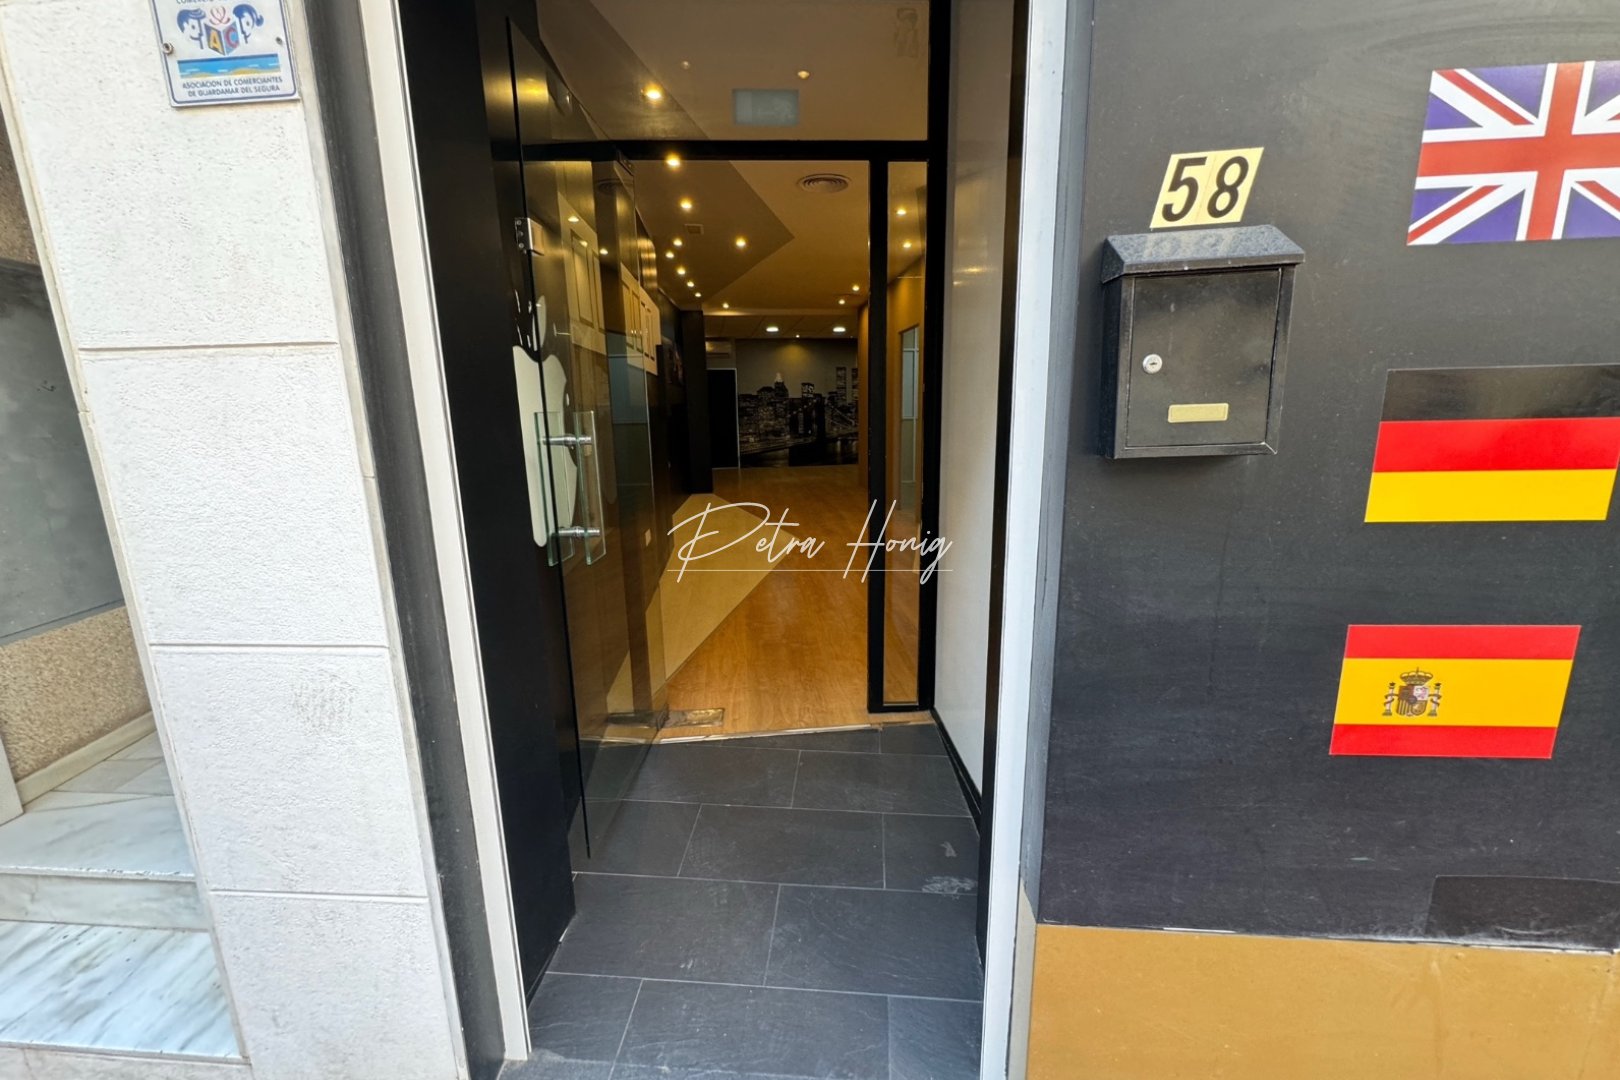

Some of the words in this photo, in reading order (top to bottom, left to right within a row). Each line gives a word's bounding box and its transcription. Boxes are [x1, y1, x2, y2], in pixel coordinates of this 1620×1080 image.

[223, 79, 232, 87] DE
[233, 76, 283, 86] COMERCIANTES
[198, 88, 239, 96] GUARDAMAR
[240, 86, 253, 94] DEL
[254, 84, 280, 93] SEGURA
[1162, 156, 1249, 222] 58
